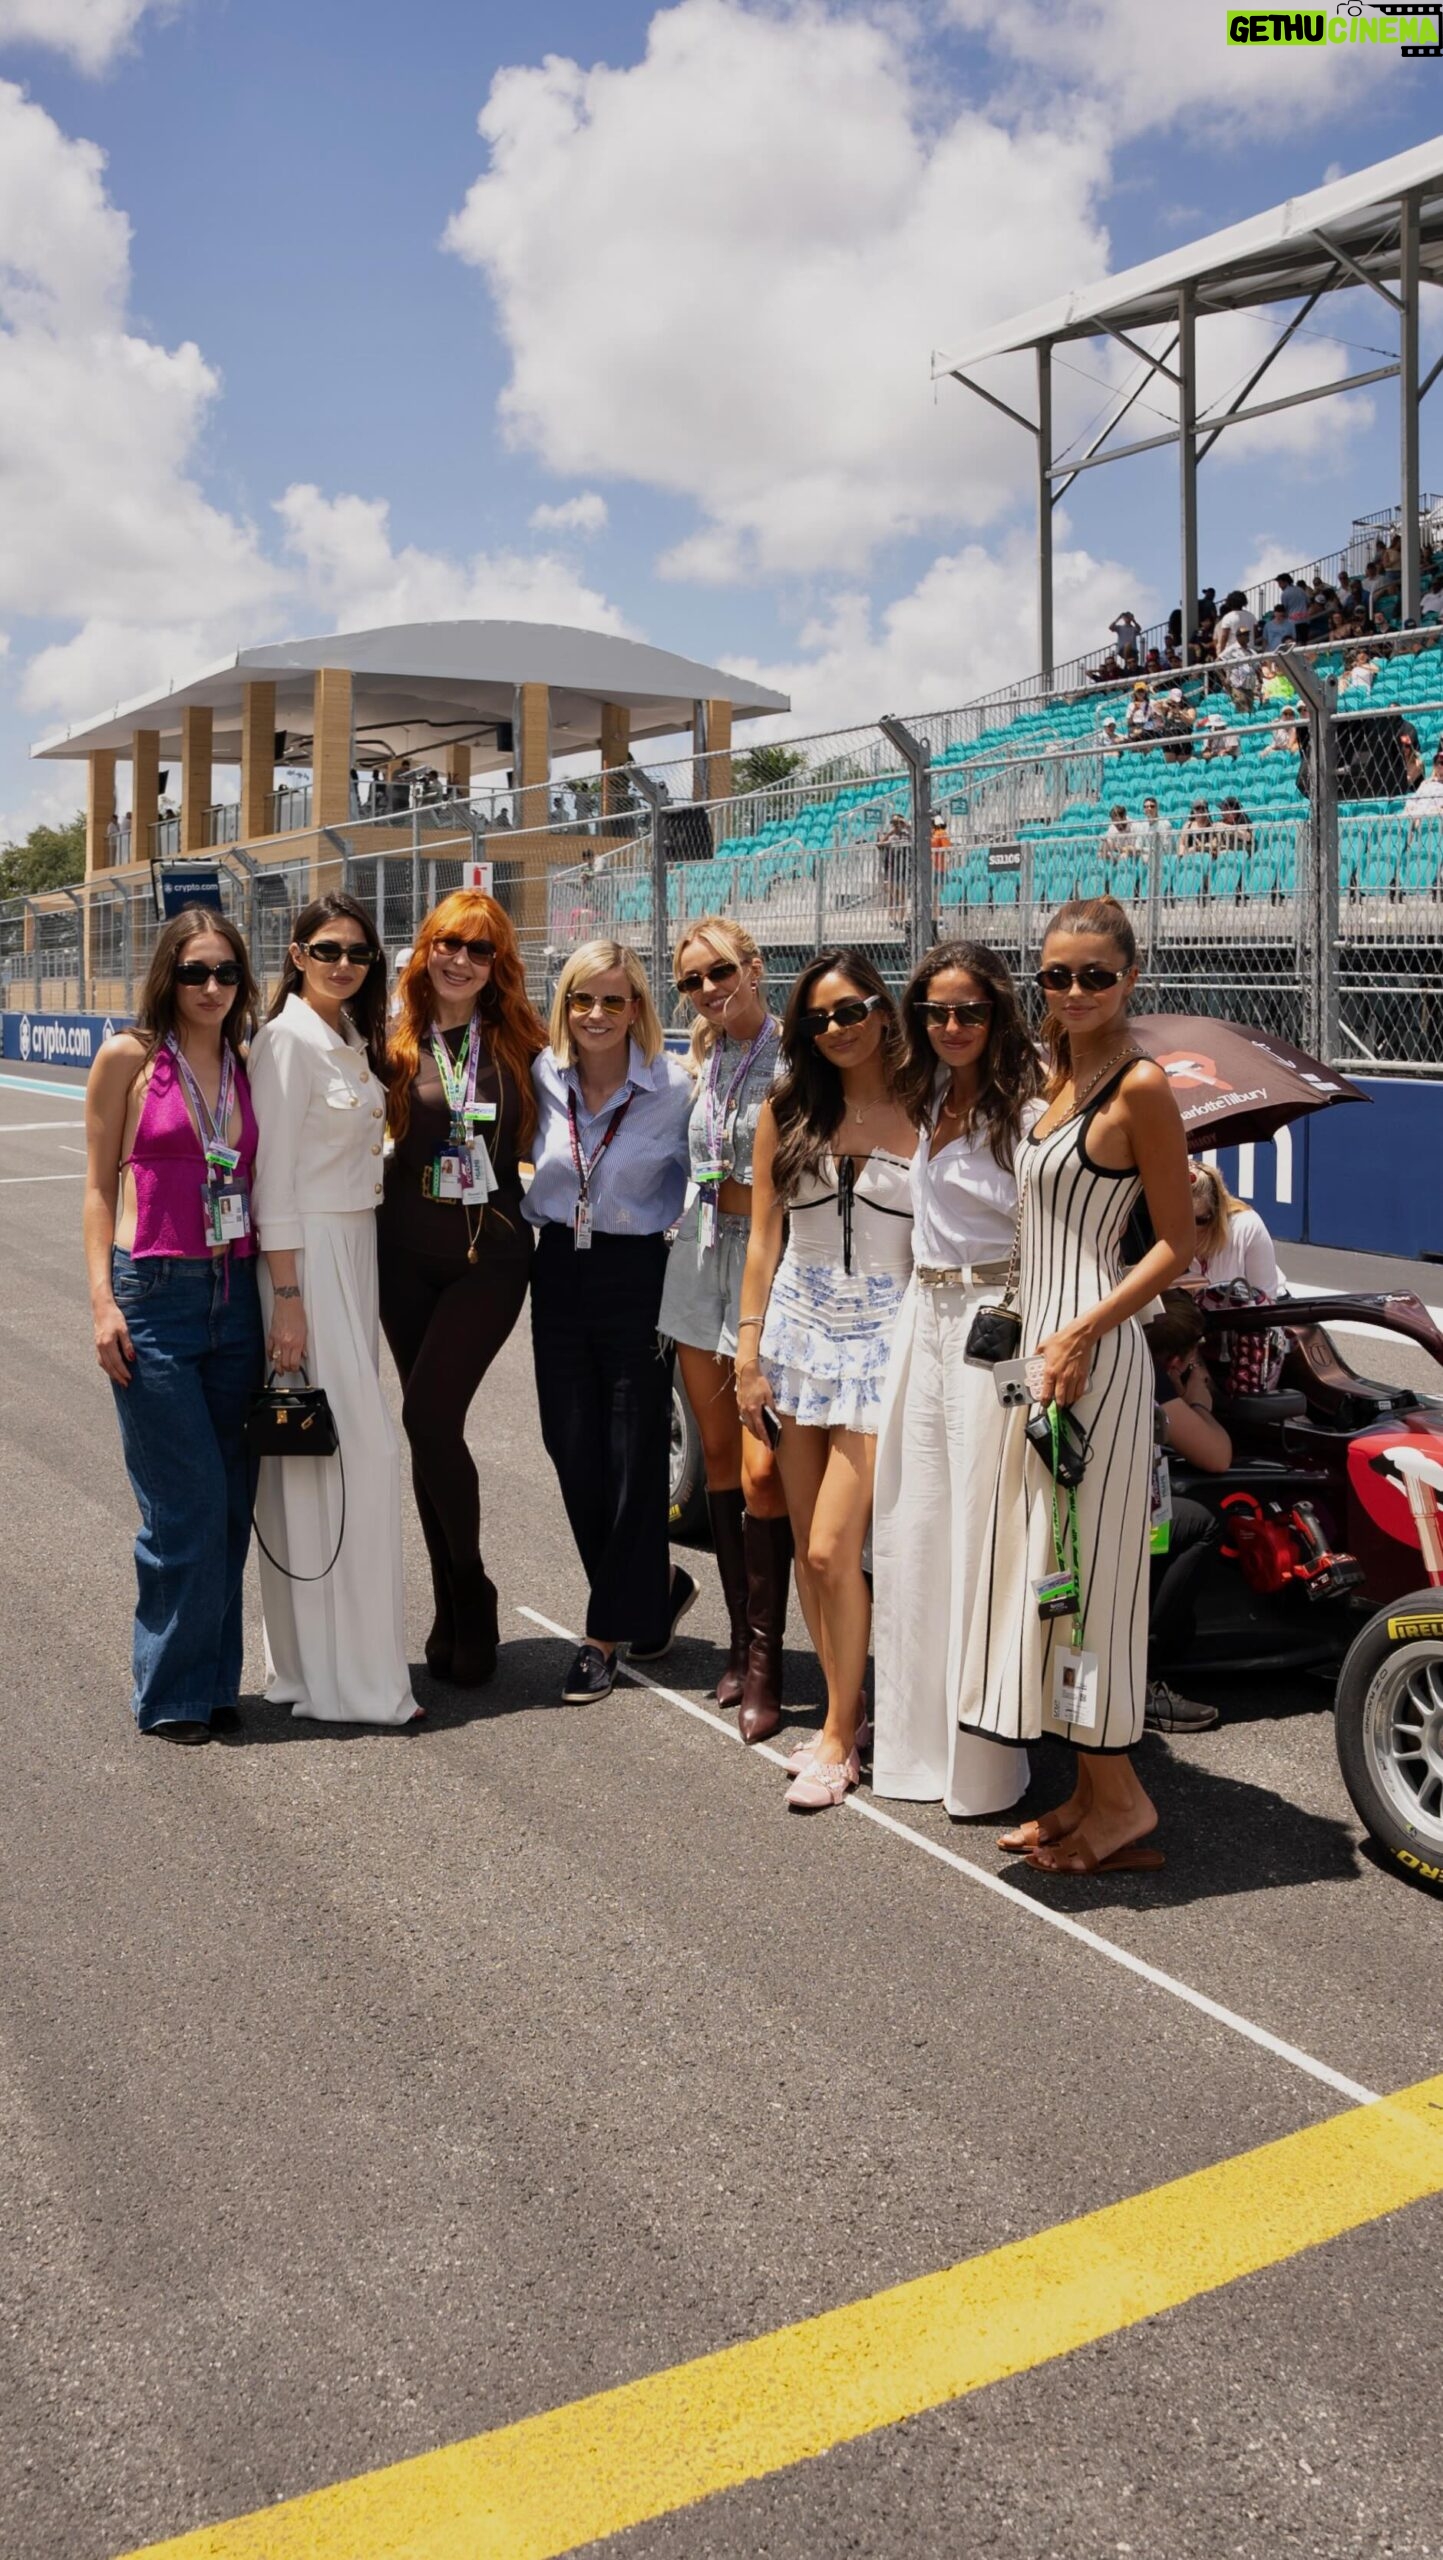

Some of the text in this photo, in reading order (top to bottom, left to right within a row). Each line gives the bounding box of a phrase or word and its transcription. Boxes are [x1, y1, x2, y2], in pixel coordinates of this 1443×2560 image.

[174, 883, 218, 892] crypto.com
[32, 1020, 91, 1060] crypto.com
[1387, 1613, 1443, 1640] PIREL
